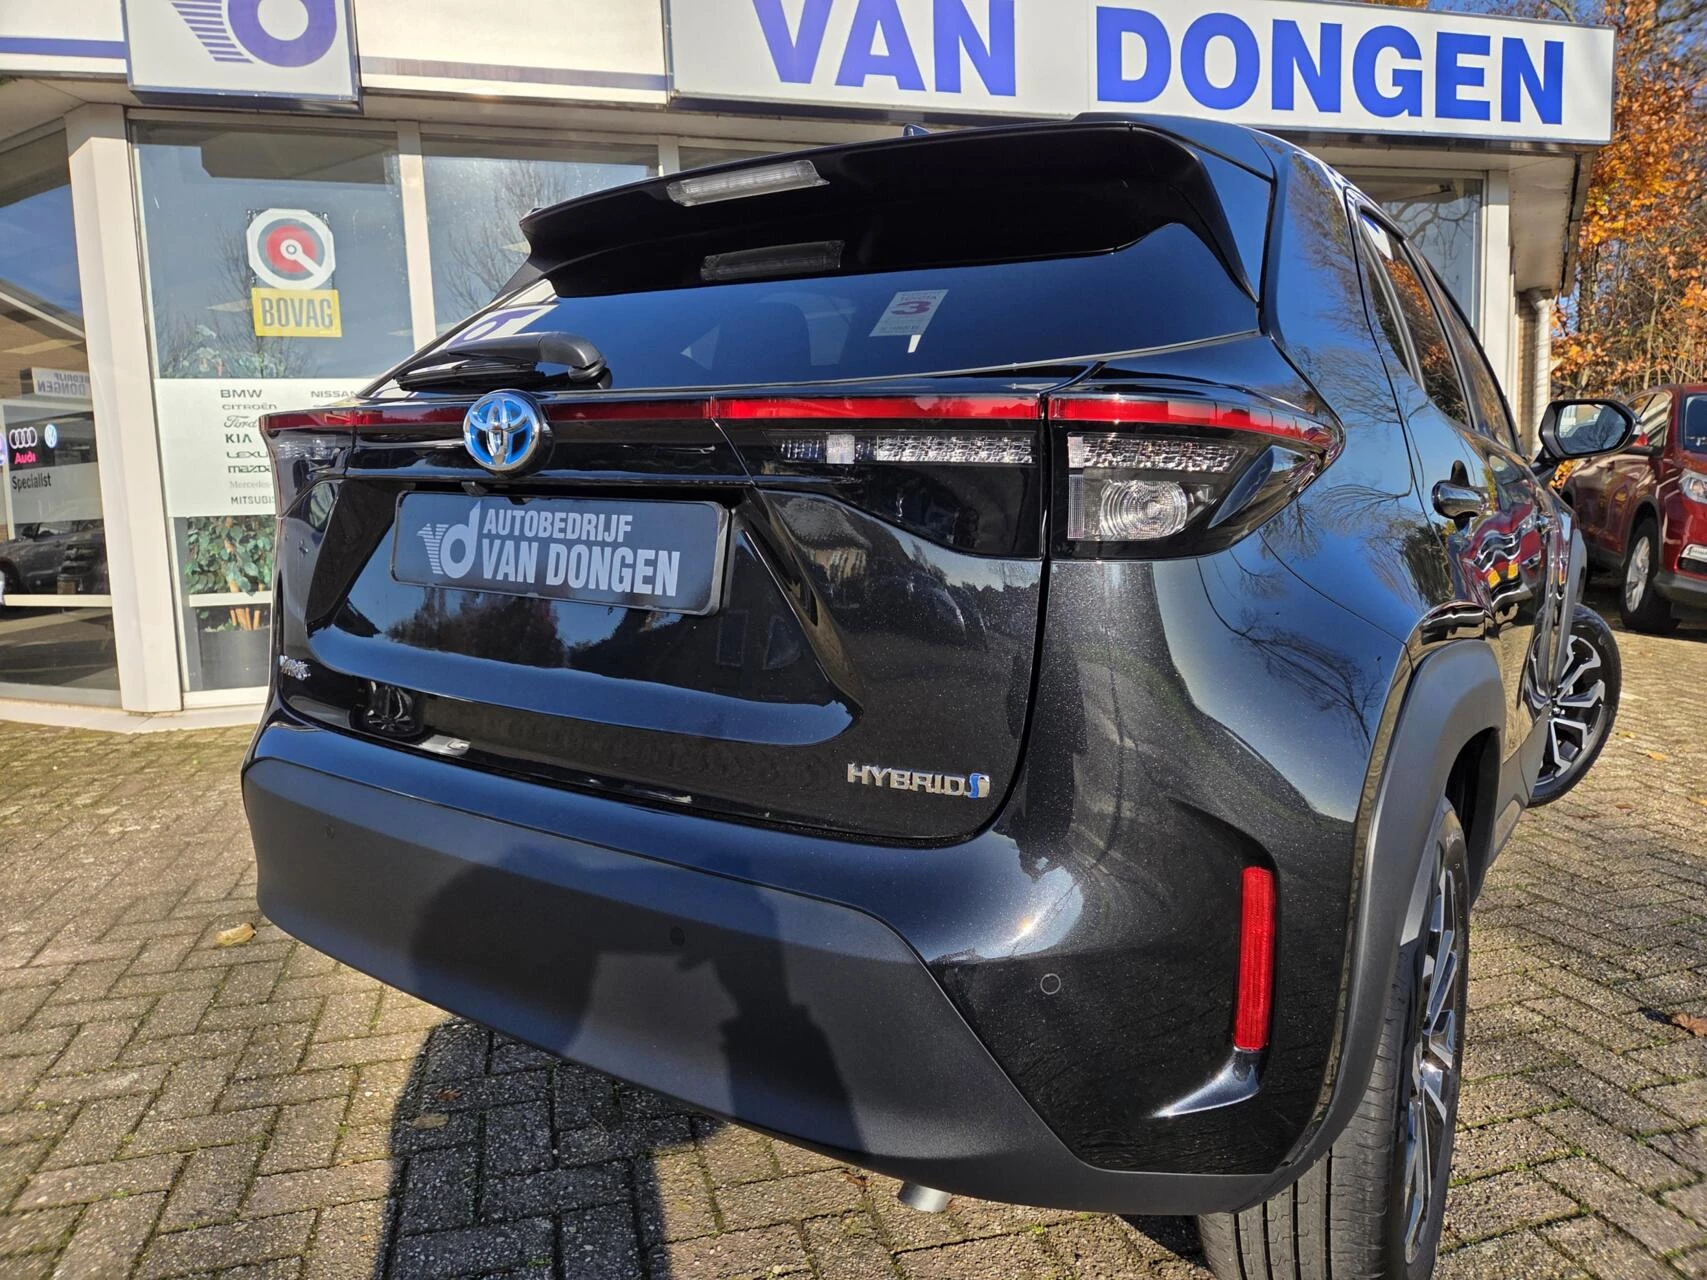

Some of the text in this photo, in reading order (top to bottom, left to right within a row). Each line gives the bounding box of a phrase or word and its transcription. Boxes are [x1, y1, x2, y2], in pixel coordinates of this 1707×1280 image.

[753, 0, 1564, 125] VAN DONGEN
[261, 297, 334, 329] BOVAG
[891, 300, 932, 316] 3
[220, 389, 262, 399] BMW
[221, 402, 278, 411] CITROËN
[223, 415, 259, 429] Ford
[225, 433, 252, 444] KIA
[14, 451, 36, 464] Audi
[226, 451, 268, 459] LEXU
[11, 471, 52, 493] Specialist
[231, 496, 275, 505] MITSUBI
[483, 508, 633, 543] AUTOBEDRIJF
[481, 538, 681, 597] VAN DONGEN
[847, 762, 966, 797] HYBRID
